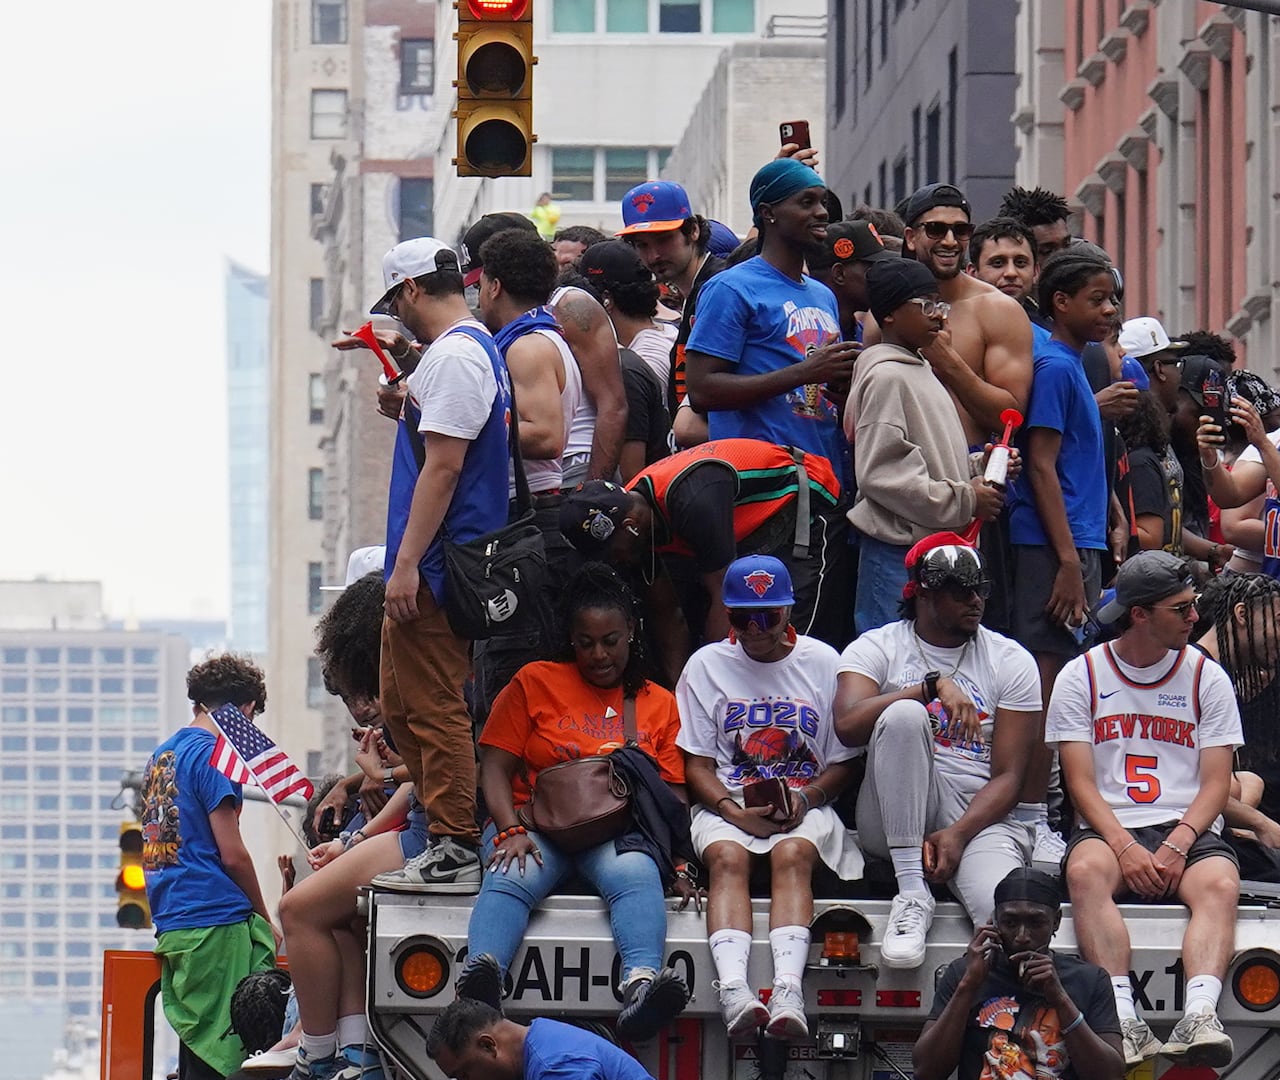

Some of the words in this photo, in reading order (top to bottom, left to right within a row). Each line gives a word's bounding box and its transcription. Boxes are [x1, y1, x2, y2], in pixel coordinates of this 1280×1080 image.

[785, 306, 839, 338] CHAMPIO
[724, 701, 820, 739] 2026
[1094, 713, 1137, 745] NEW
[1138, 713, 1196, 749] YORK
[727, 761, 817, 781] FNALS
[1125, 753, 1162, 804] 5
[790, 1048, 819, 1059] GER
